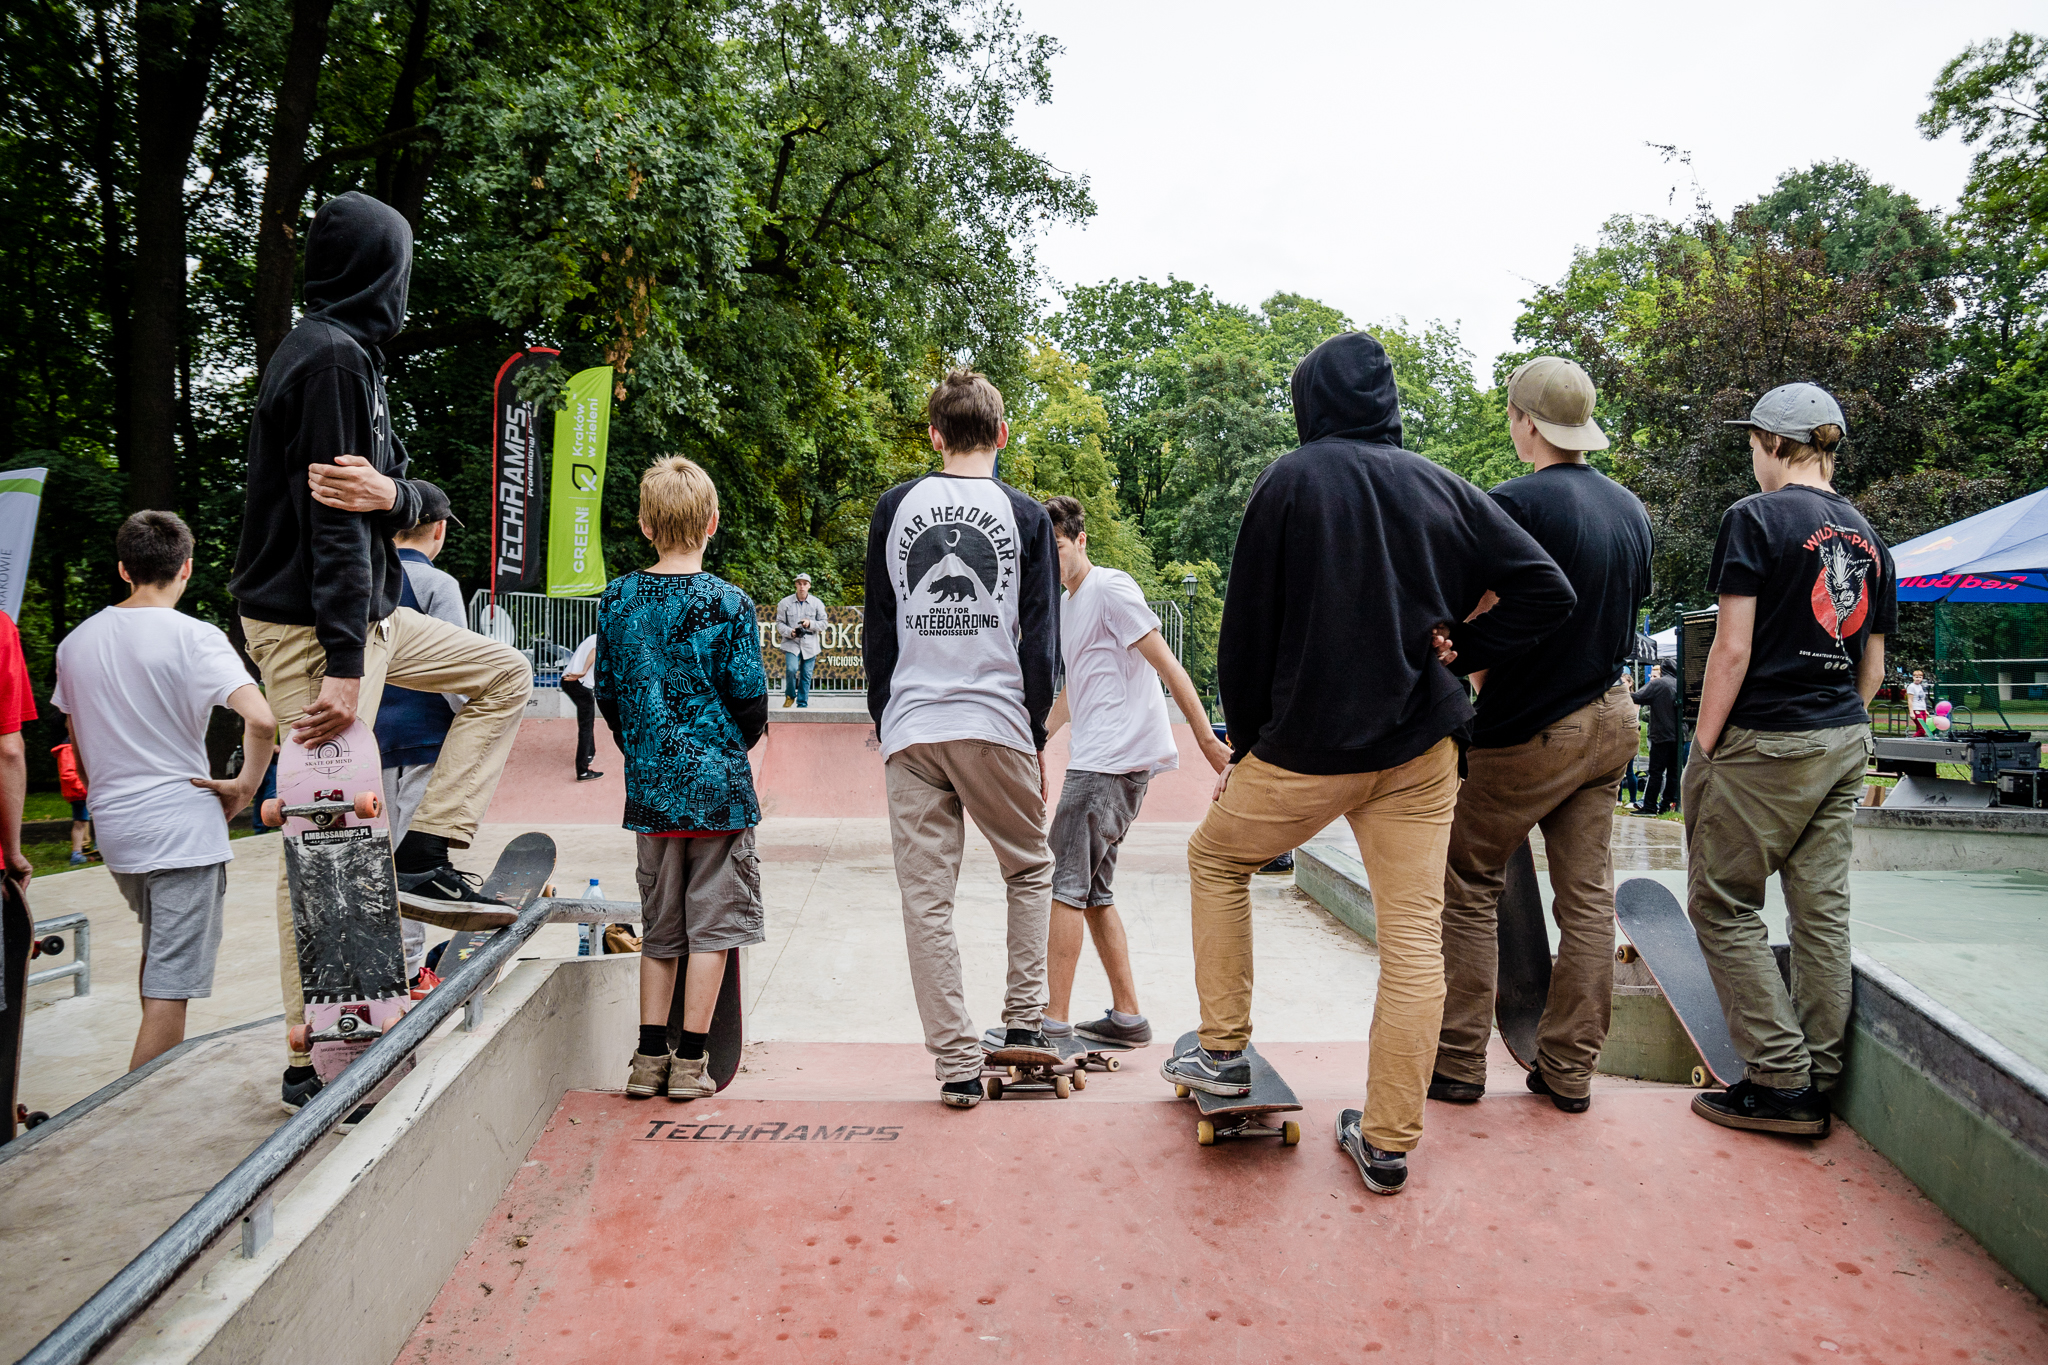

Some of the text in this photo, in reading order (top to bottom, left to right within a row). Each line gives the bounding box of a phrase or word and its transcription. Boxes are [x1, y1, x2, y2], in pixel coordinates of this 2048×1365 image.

[572, 402, 585, 457] Kraków
[586, 398, 599, 458] w zieleni
[527, 436, 535, 497] Professional
[573, 512, 590, 574] GREEN
[898, 505, 1016, 562] BEAR HEADWEAR
[1802, 526, 1833, 552] WILD
[0, 548, 13, 610] RAKOWIE
[905, 614, 999, 629] SKATEBOARDING
